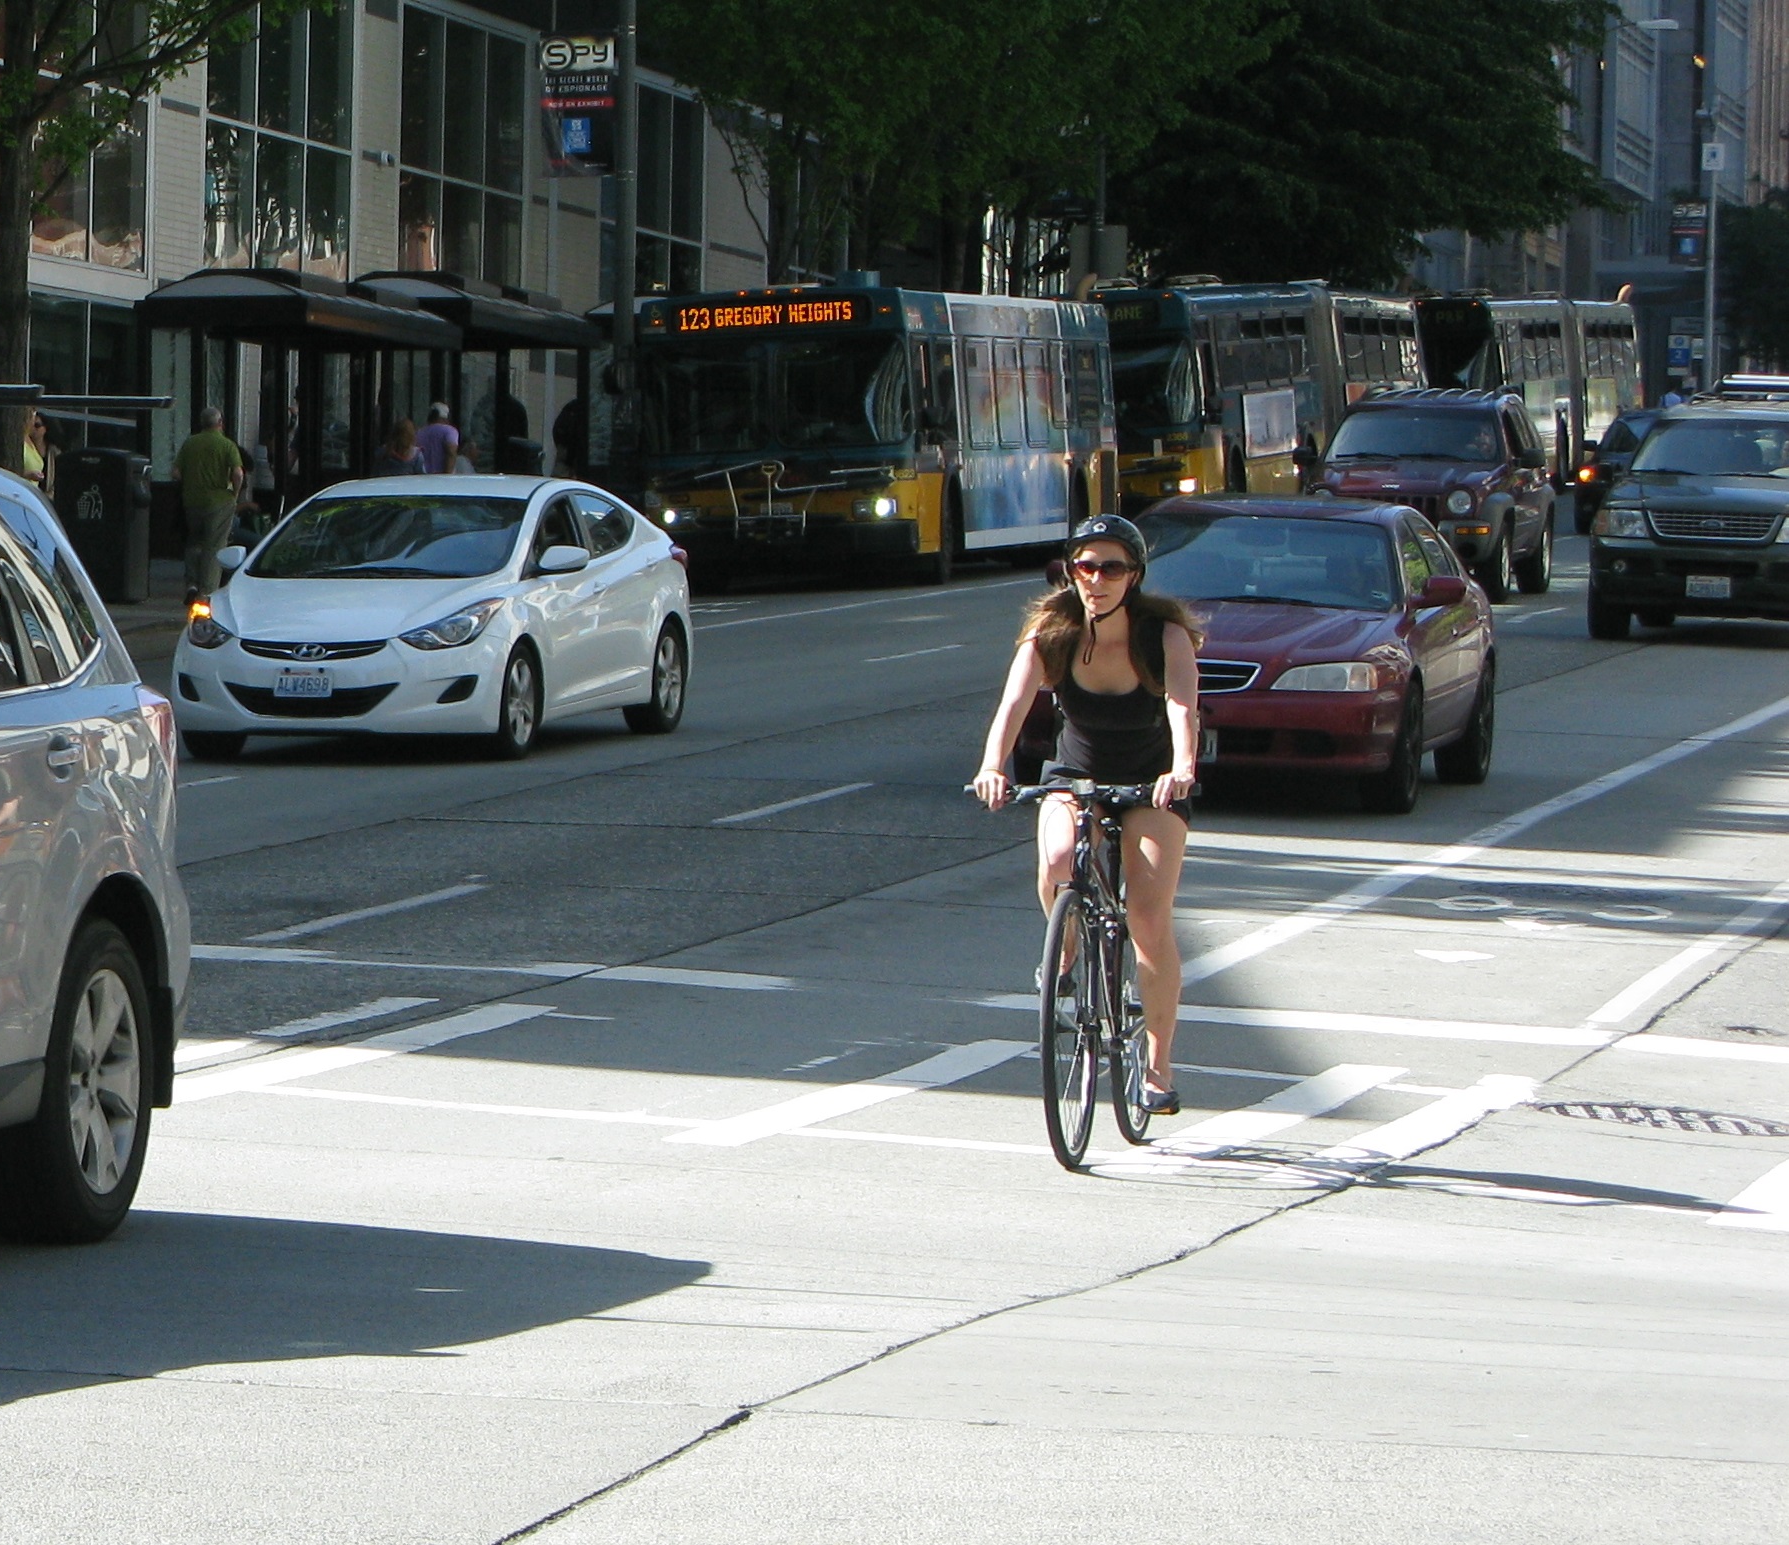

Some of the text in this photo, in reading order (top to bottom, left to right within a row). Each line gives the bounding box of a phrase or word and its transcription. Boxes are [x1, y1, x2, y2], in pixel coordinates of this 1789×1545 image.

[546, 43, 608, 66] SPY
[559, 84, 608, 93] ESPIONAGE
[679, 300, 853, 331] 123 GREGORY HEIGHTS
